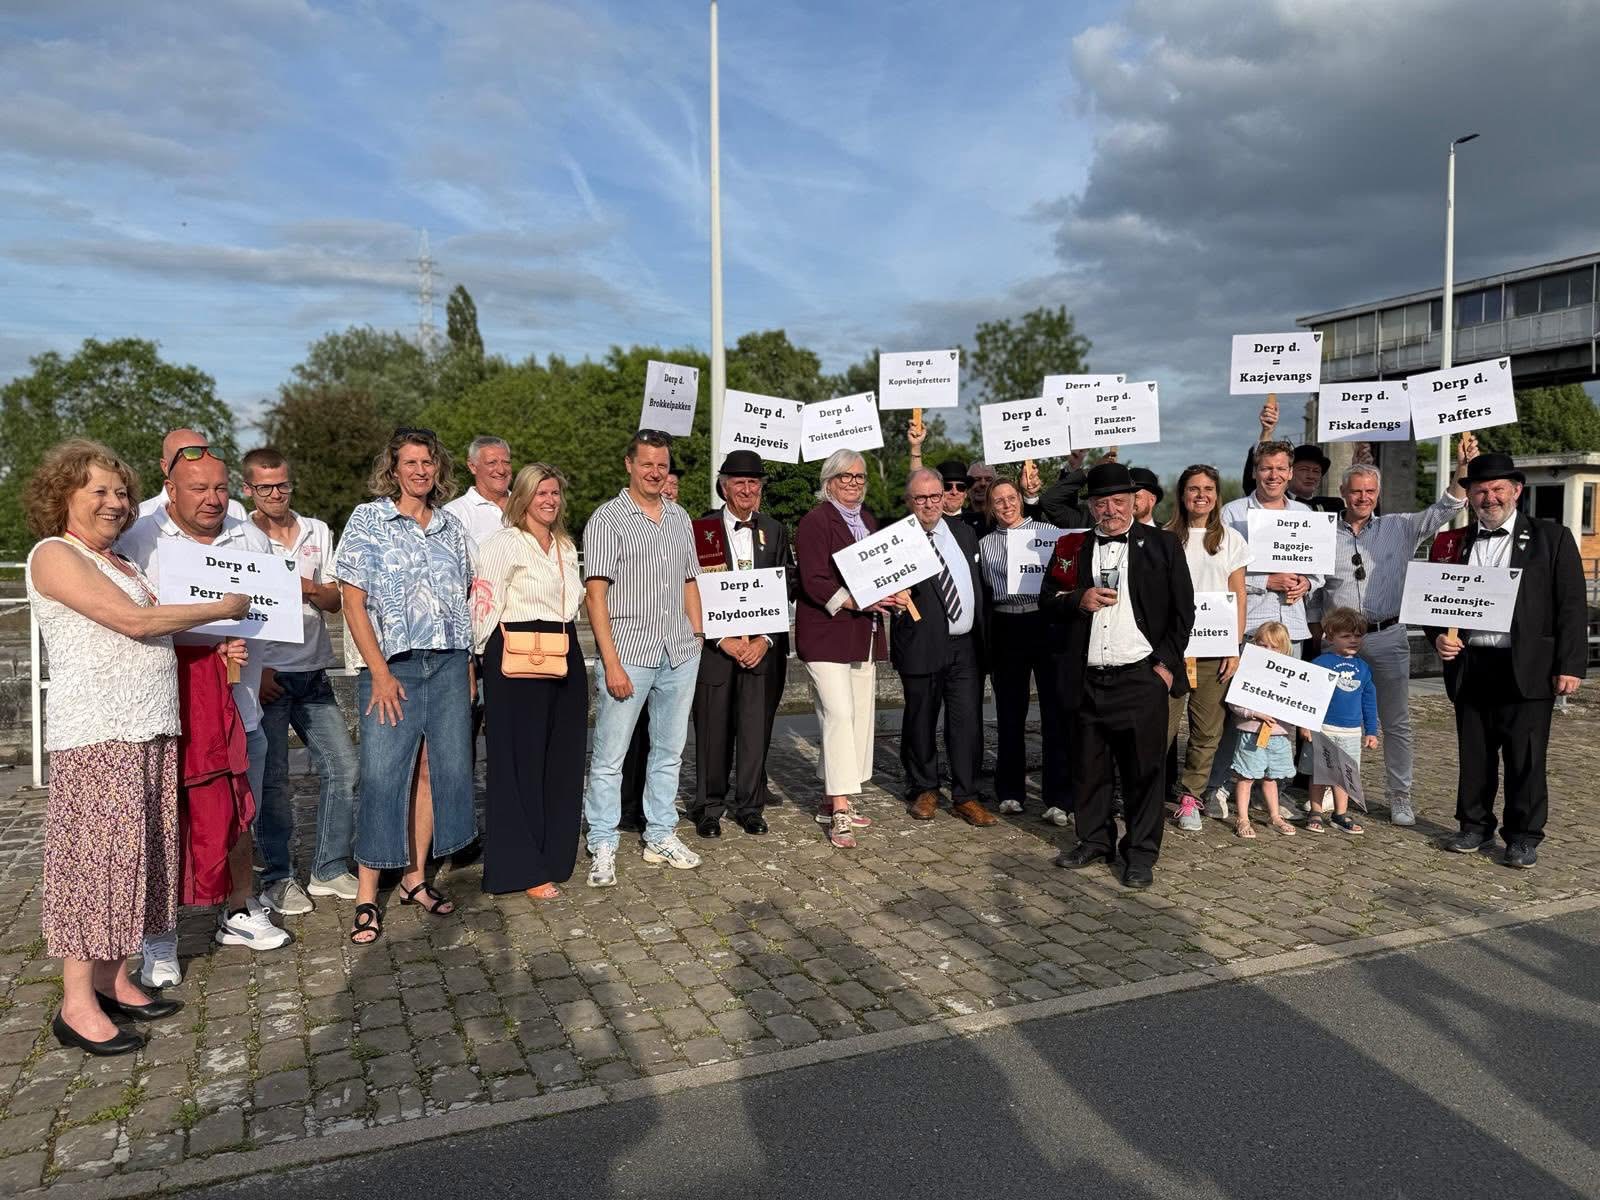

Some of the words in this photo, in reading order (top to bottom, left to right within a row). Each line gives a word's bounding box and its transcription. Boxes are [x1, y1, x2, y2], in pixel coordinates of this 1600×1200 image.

[1254, 343, 1285, 354] Derp
[1288, 341, 1301, 351] d.
[906, 359, 924, 368] Derp
[925, 358, 934, 366] d.
[664, 374, 677, 385] Derp
[678, 375, 685, 385] d.
[889, 377, 951, 387] Kopvliejsfretters
[1240, 372, 1311, 384] Kazjevangs
[1432, 379, 1468, 392] Derp
[1474, 373, 1487, 384] d.
[1097, 394, 1120, 403] Derp
[1121, 391, 1131, 400] d.
[1342, 392, 1373, 403] Derp
[1376, 390, 1389, 400] d.
[649, 398, 692, 411] Brokkelpakken
[744, 403, 771, 418] Derp
[774, 407, 786, 418] d.
[819, 408, 843, 418] Derp
[844, 404, 855, 413] d.
[1002, 410, 1032, 421] Derp
[1035, 406, 1047, 416] d.
[1095, 415, 1136, 425] Flauzen-
[1438, 407, 1491, 424] Paffers
[1095, 426, 1137, 436] maukers
[1329, 420, 1401, 432] Fiskadengs
[809, 424, 872, 442] Toitendroiers
[734, 433, 788, 449] Anzjeveis
[1004, 438, 1050, 452] Zjoebes
[1277, 519, 1300, 529] Derp
[1301, 520, 1312, 529] d.
[858, 543, 890, 563] Derp
[891, 534, 904, 545] d.
[1034, 538, 1057, 548] Der
[1273, 541, 1314, 552] Bagozje-
[1272, 553, 1313, 563] maukers
[206, 557, 242, 572] Derp
[246, 562, 261, 573] d.
[873, 562, 918, 590] Eirpels
[1441, 572, 1471, 583] Derp
[1473, 574, 1485, 584] d.
[721, 581, 750, 591] Derp
[752, 578, 764, 588] d.
[1200, 601, 1211, 611] d.
[1424, 594, 1495, 609] Kadoensjte-
[708, 608, 780, 622] Polydoorkes
[1431, 607, 1483, 617] maukers
[1266, 660, 1296, 679] Derp
[1298, 671, 1310, 682] d.
[1240, 681, 1317, 715] Estekwieten
